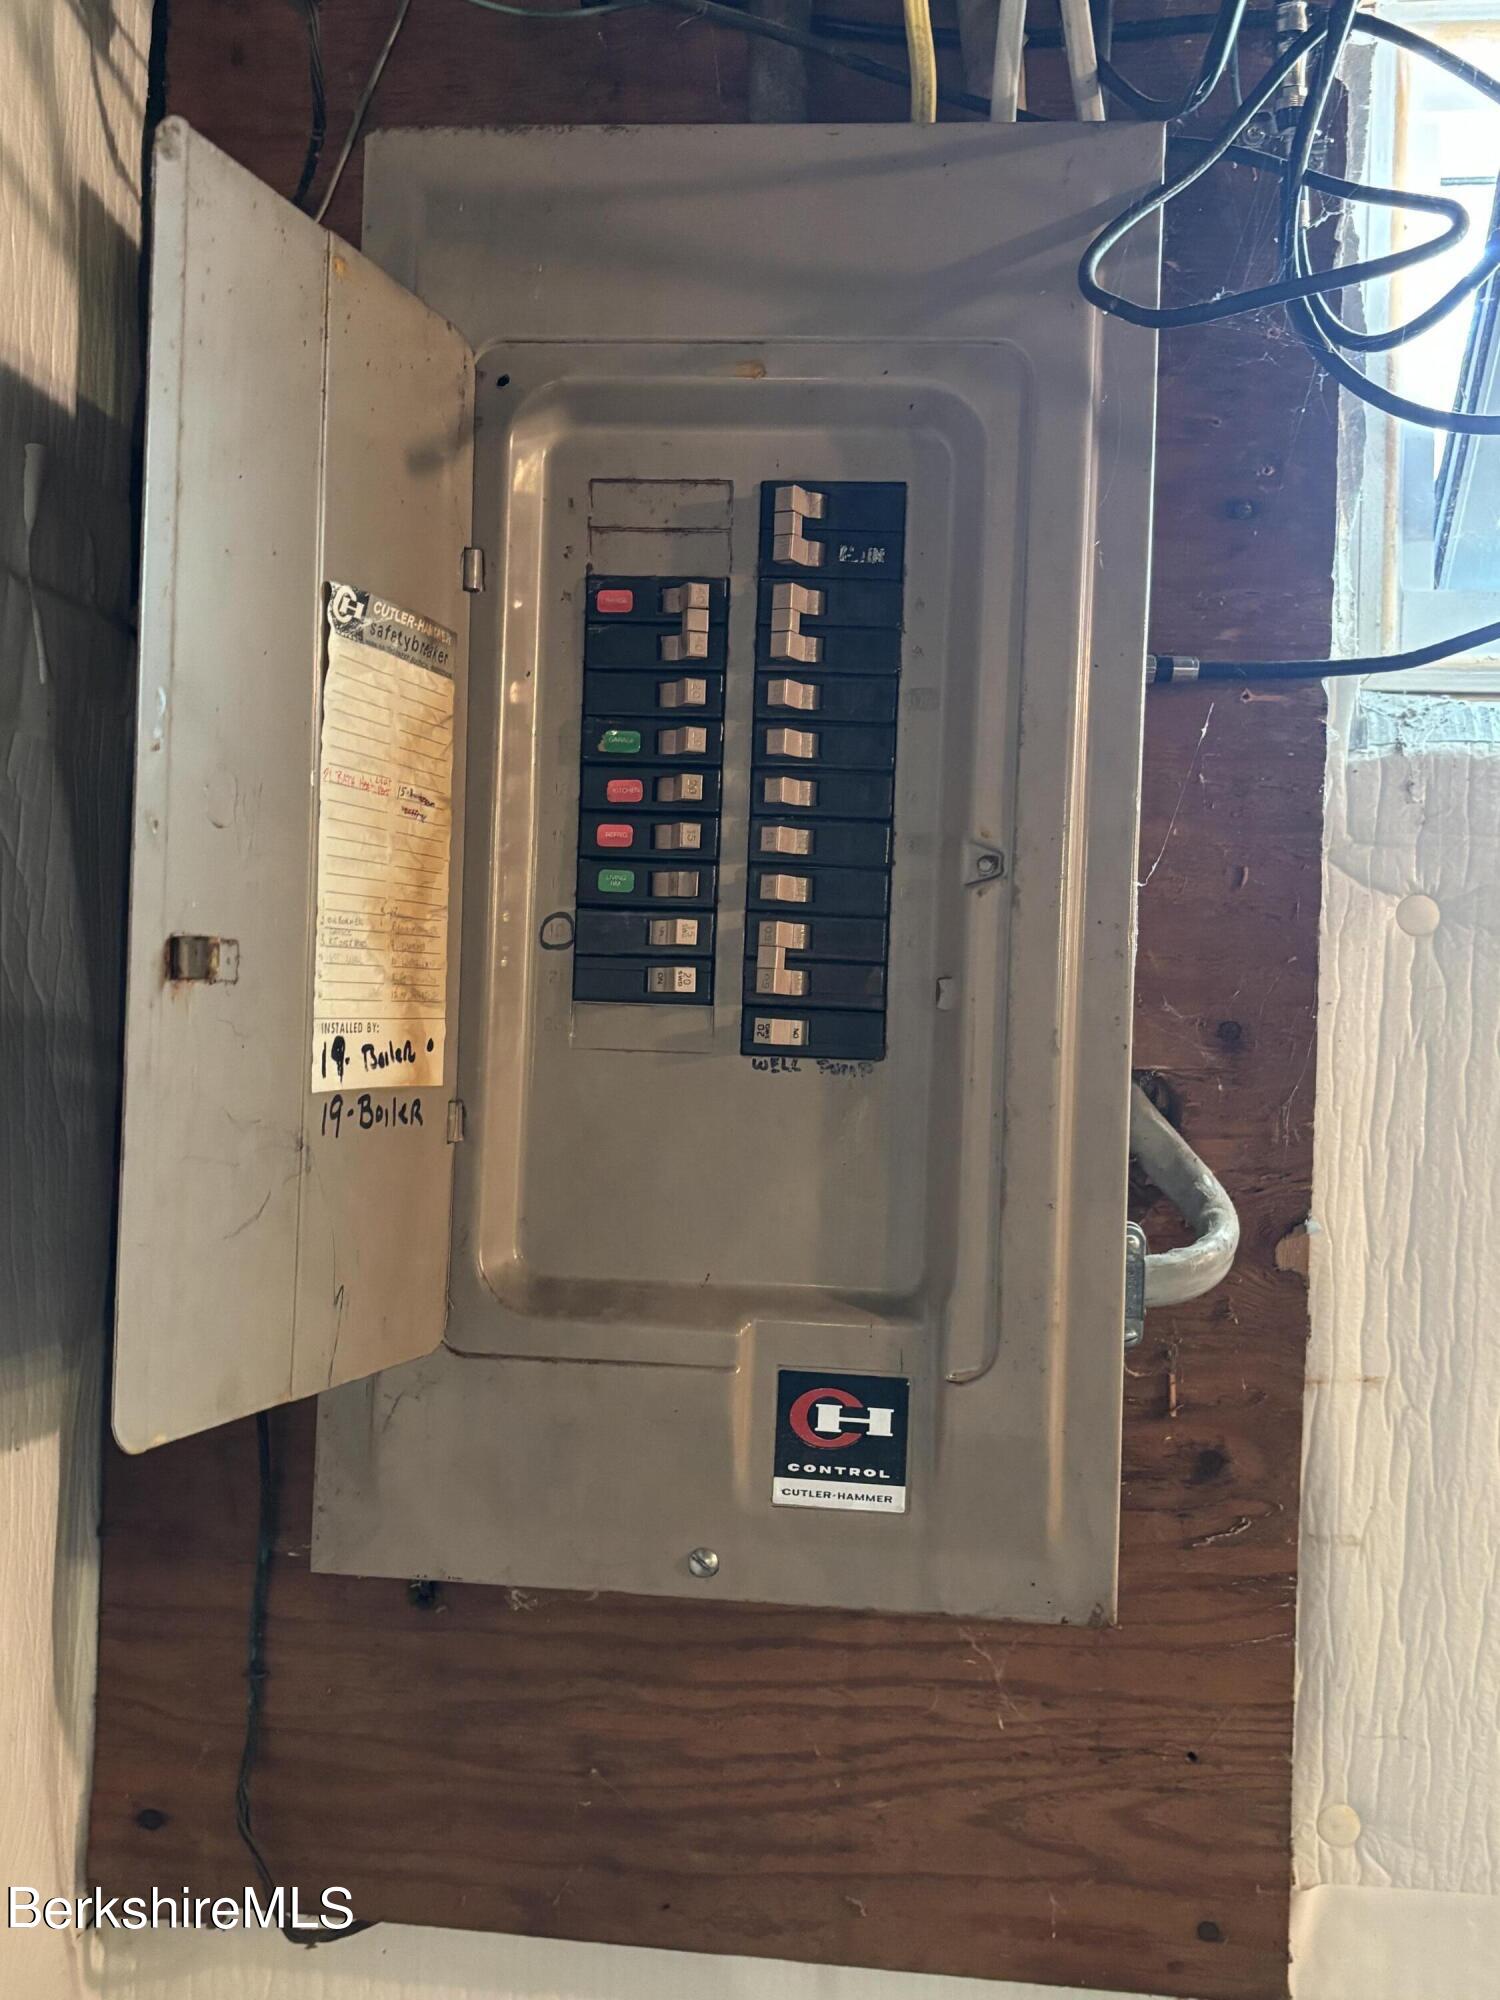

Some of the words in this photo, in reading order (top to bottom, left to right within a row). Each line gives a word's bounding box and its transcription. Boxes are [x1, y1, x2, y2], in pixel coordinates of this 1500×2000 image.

[370, 622, 449, 665] safetybreaker
[682, 972, 692, 986] 20
[321, 1022, 363, 1035] INSTALLED
[366, 1022, 380, 1034] BY:
[757, 1023, 765, 1038] 20
[787, 1463, 891, 1479] CONTROL
[781, 1488, 893, 1504] CUTLER-HAMMER
